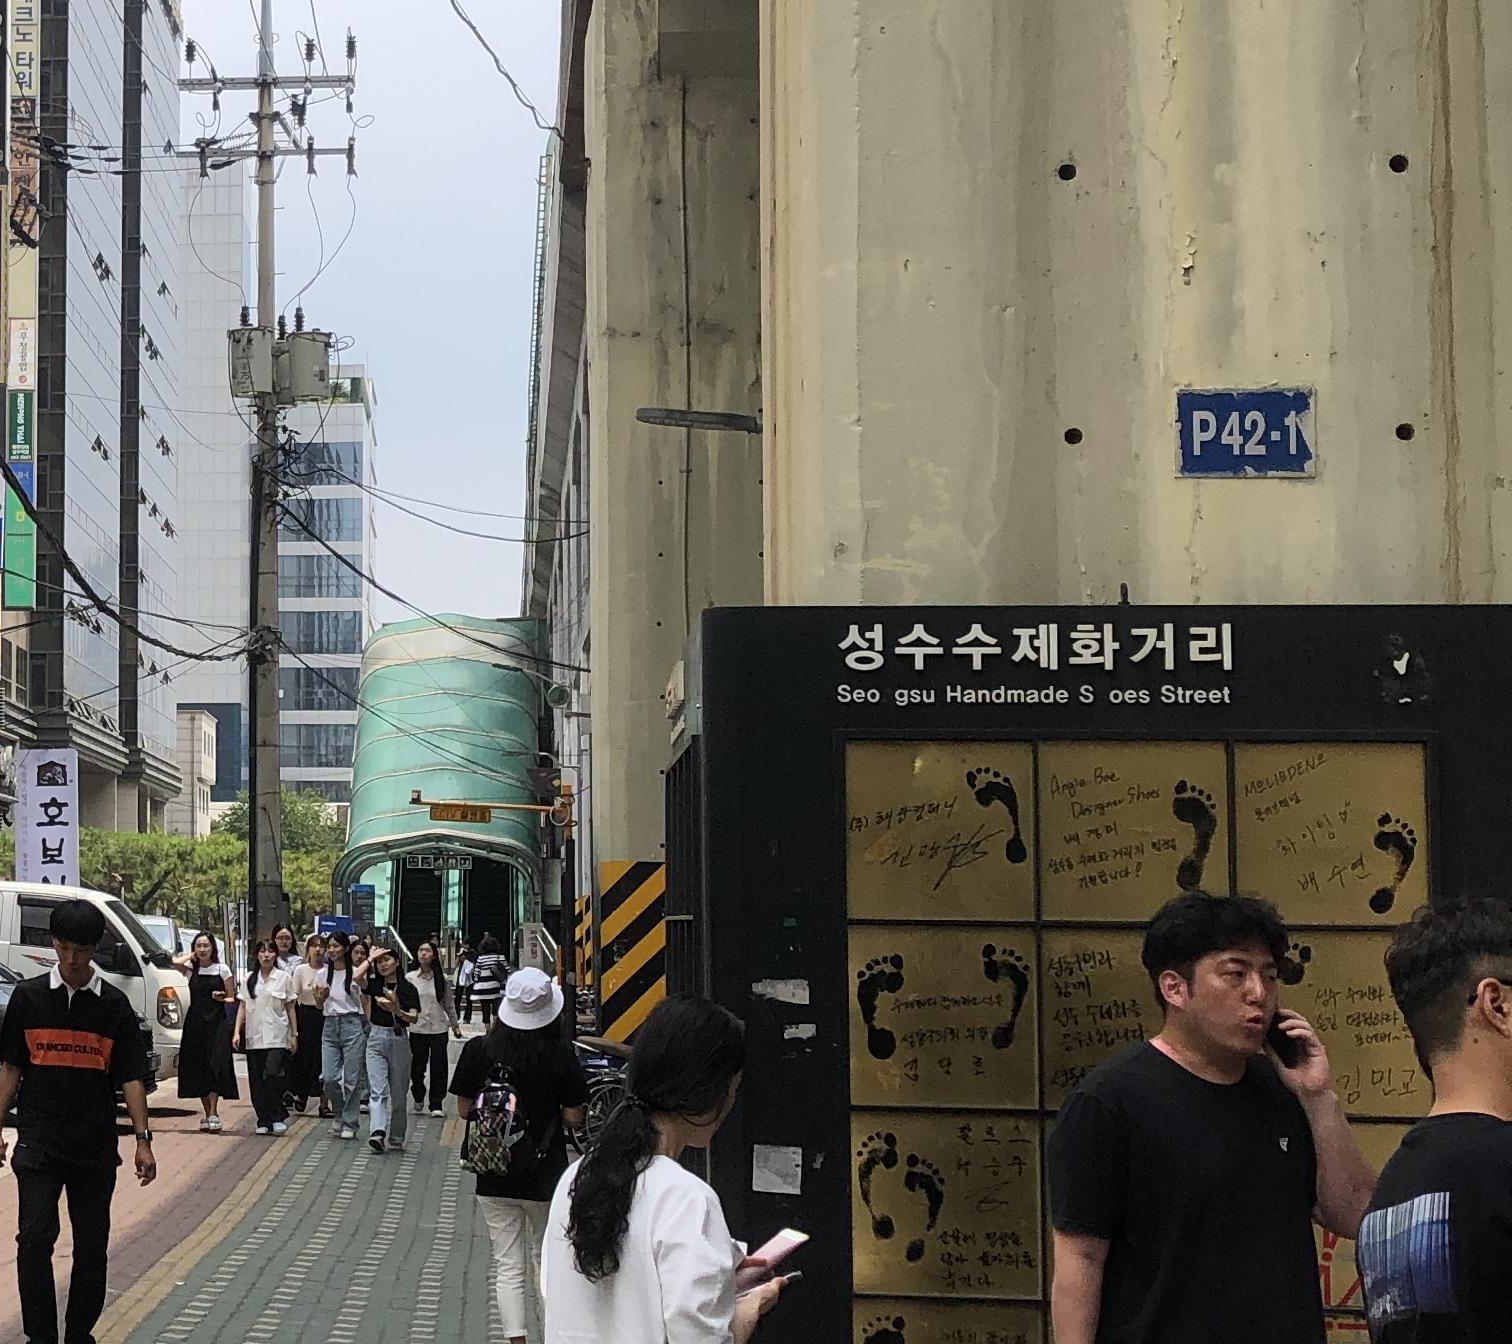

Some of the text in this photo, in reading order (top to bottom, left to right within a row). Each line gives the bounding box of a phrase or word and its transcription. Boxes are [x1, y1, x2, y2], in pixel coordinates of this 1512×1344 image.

[1191, 408, 1301, 458] P42-1
[946, 684, 1070, 704] Handmade
[1161, 684, 1231, 704] Street
